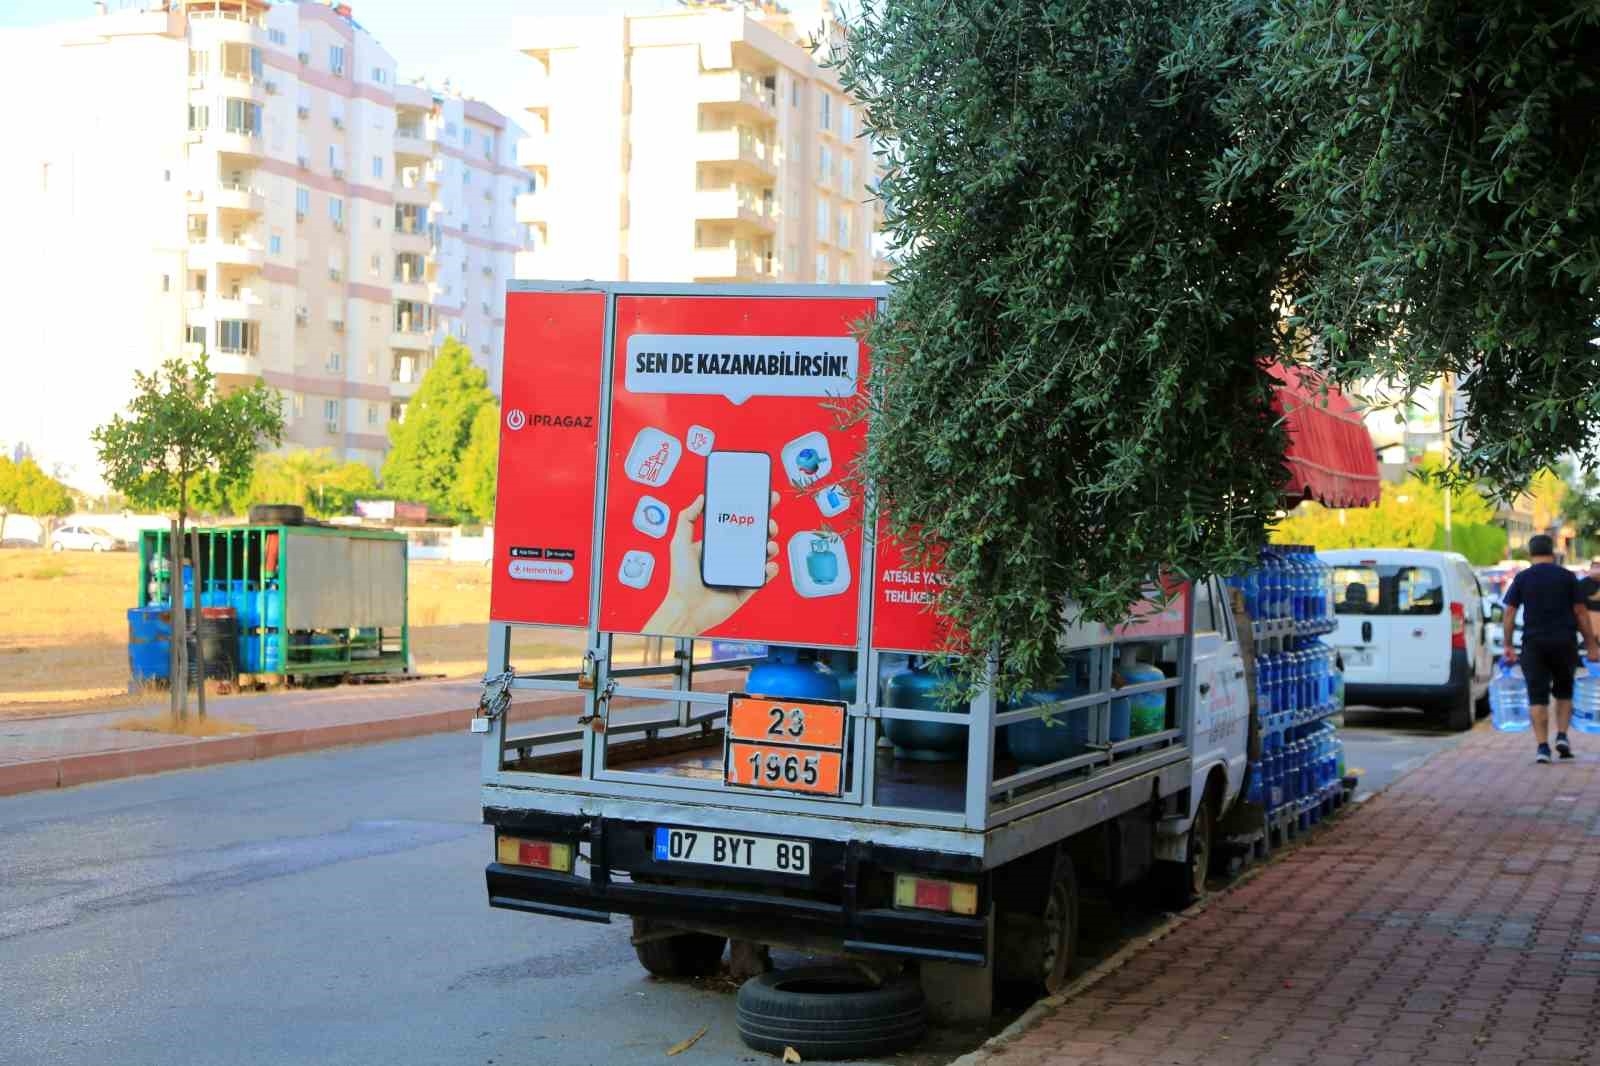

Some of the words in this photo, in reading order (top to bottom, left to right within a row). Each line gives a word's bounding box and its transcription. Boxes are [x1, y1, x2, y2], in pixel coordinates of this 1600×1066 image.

[635, 352, 667, 374] SEN
[672, 353, 694, 374] DE
[697, 351, 848, 377] KAZANABİLİRSİN!
[882, 569, 921, 585] ATEŞLE
[768, 708, 804, 736] 23
[749, 753, 818, 785] 1965
[669, 831, 698, 859] 07
[713, 835, 756, 865] BYT
[776, 843, 805, 871] 89
